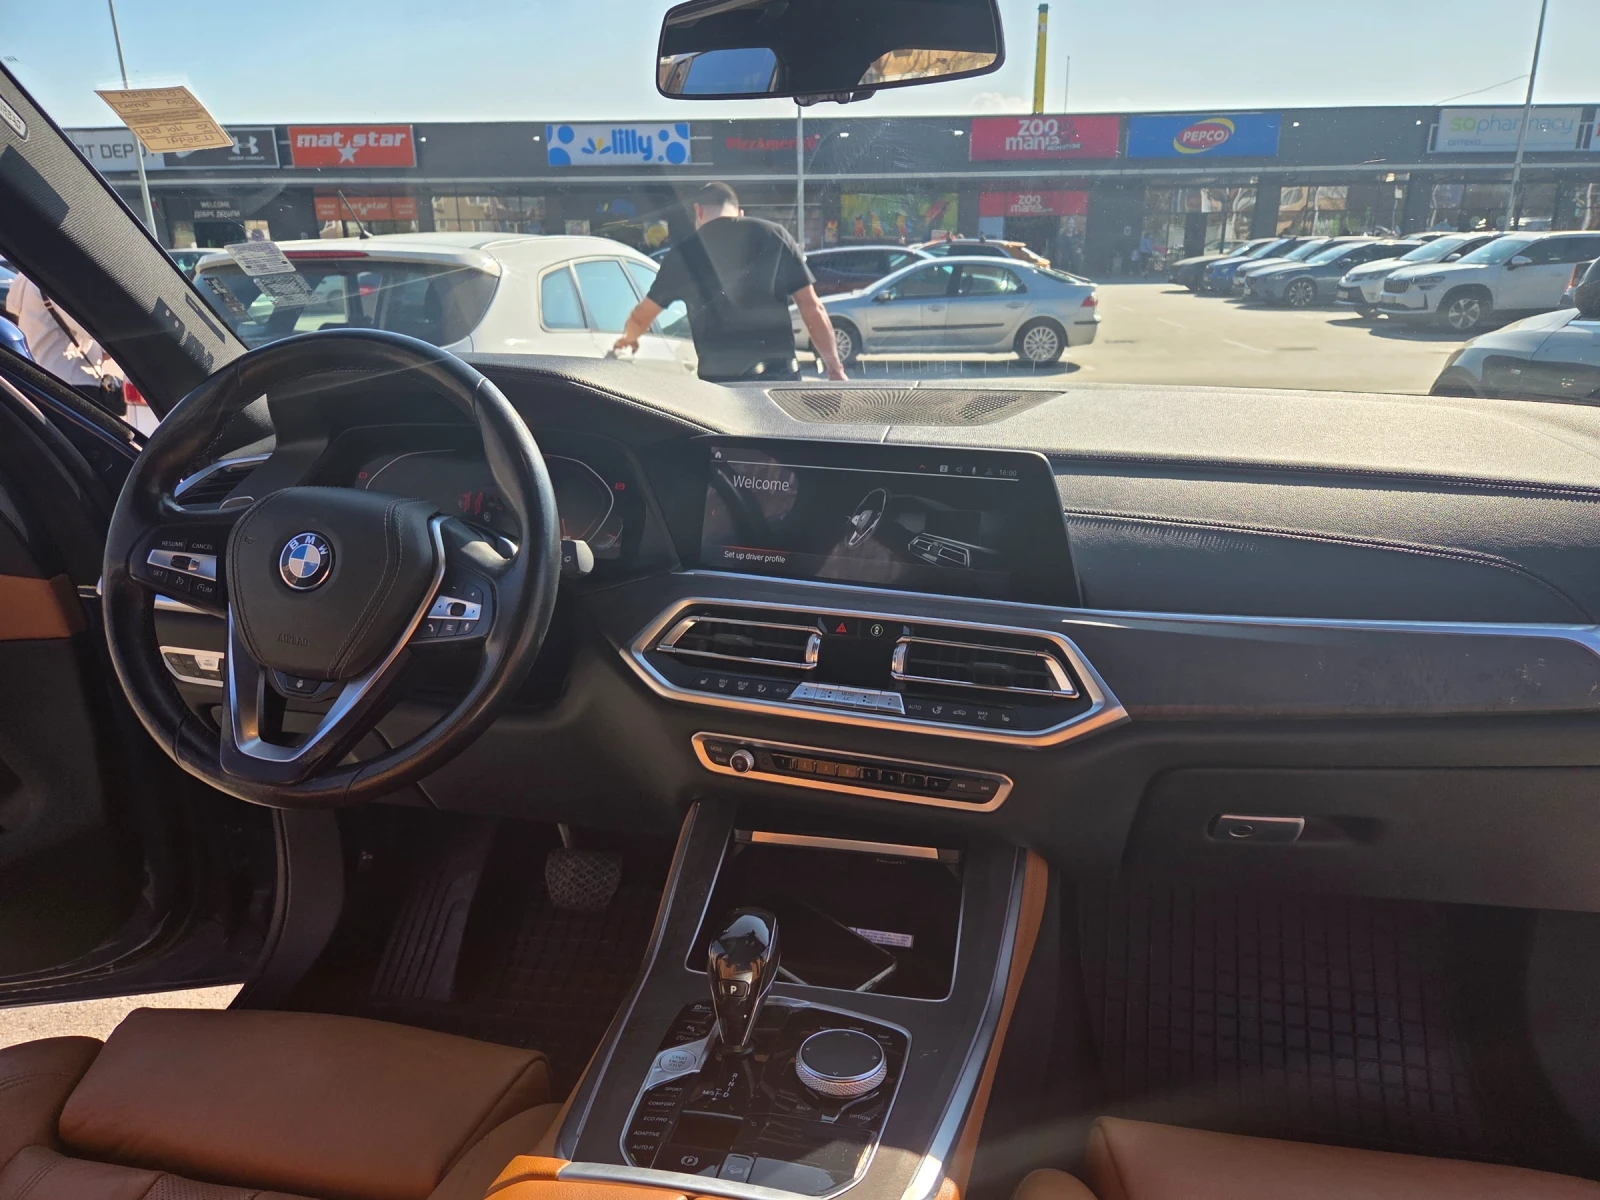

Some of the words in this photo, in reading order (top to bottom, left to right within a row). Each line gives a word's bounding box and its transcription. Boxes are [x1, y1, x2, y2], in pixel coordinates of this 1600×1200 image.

[297, 131, 344, 147] mat
[352, 131, 406, 147] star
[1182, 130, 1225, 142] PEPCO
[612, 128, 653, 161] lilly
[733, 475, 790, 491] Welcome
[161, 540, 184, 548] RESUME
[289, 535, 329, 555] BMW
[724, 550, 735, 559] Set
[736, 552, 745, 561] up
[745, 552, 764, 562] driver
[764, 555, 786, 564] profile
[730, 985, 737, 995] P
[633, 1130, 661, 1138] ADAPTIVE
